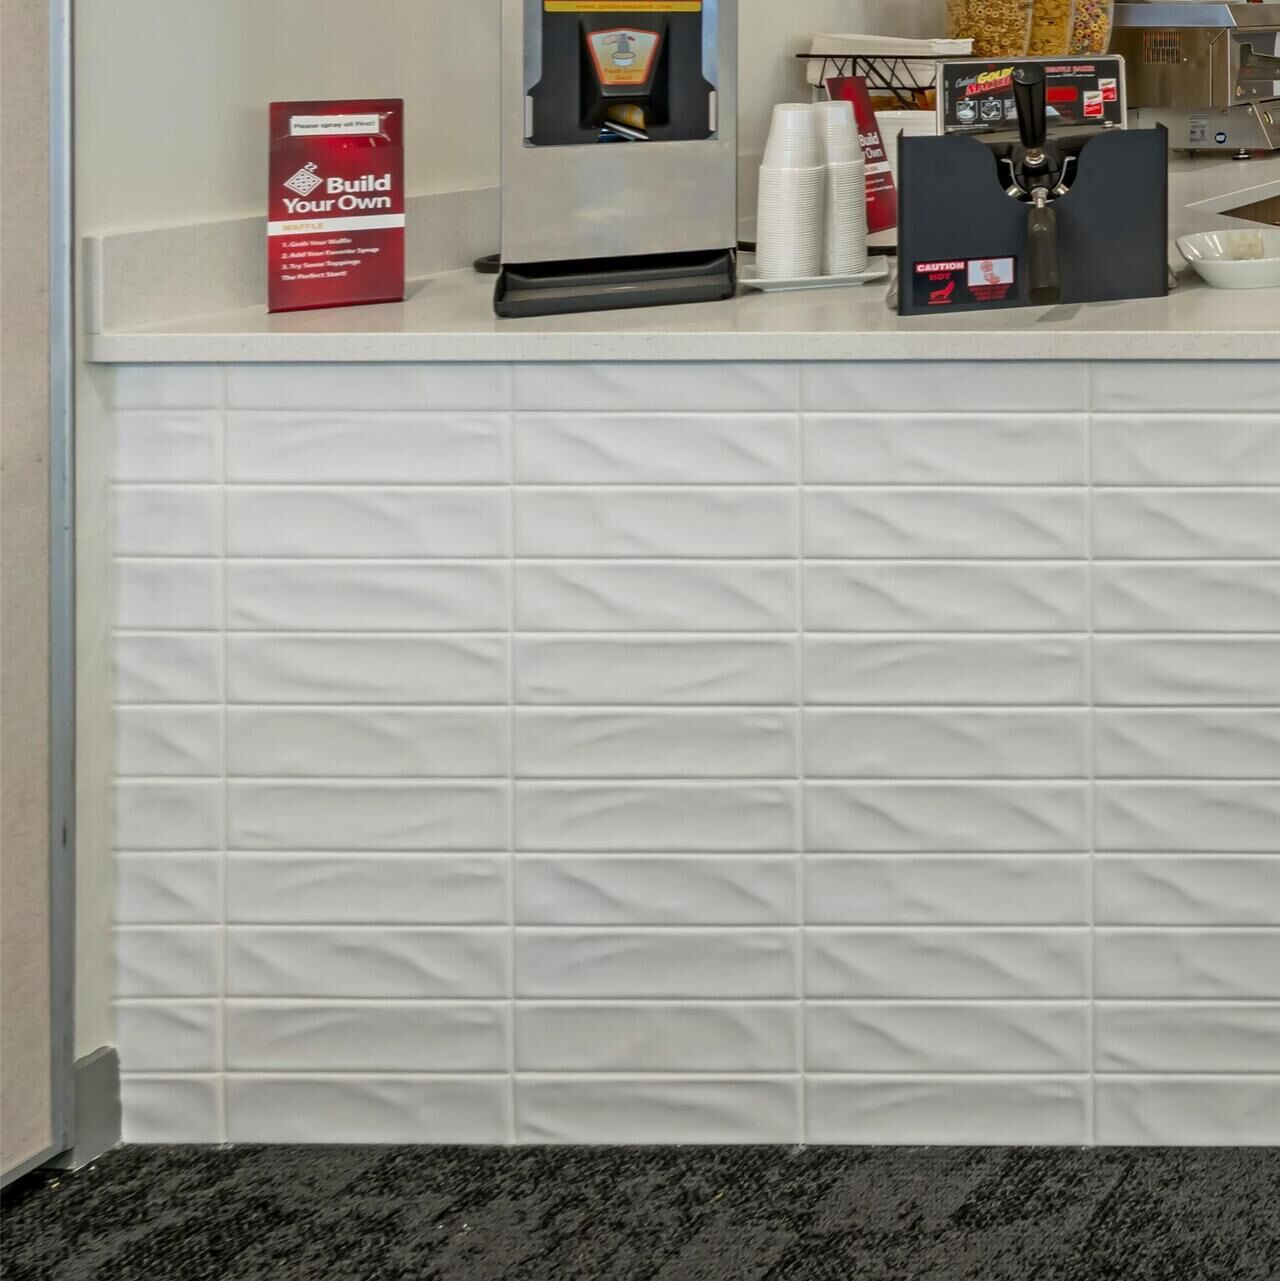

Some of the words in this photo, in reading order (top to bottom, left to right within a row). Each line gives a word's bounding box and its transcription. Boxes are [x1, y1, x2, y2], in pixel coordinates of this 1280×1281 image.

[858, 131, 880, 147] Build
[326, 173, 392, 194] Build
[282, 197, 336, 214] Your
[337, 194, 392, 211] Own
[282, 222, 325, 232] WAFFLE
[289, 240, 309, 248] Grab
[328, 237, 353, 245] Waffle
[289, 251, 306, 259] Add
[356, 247, 380, 255] Syrup
[289, 263, 302, 271] Try
[326, 259, 362, 267] Toppings
[916, 261, 965, 273] CAUTION
[281, 273, 297, 281] The
[297, 272, 325, 280] Perfect
